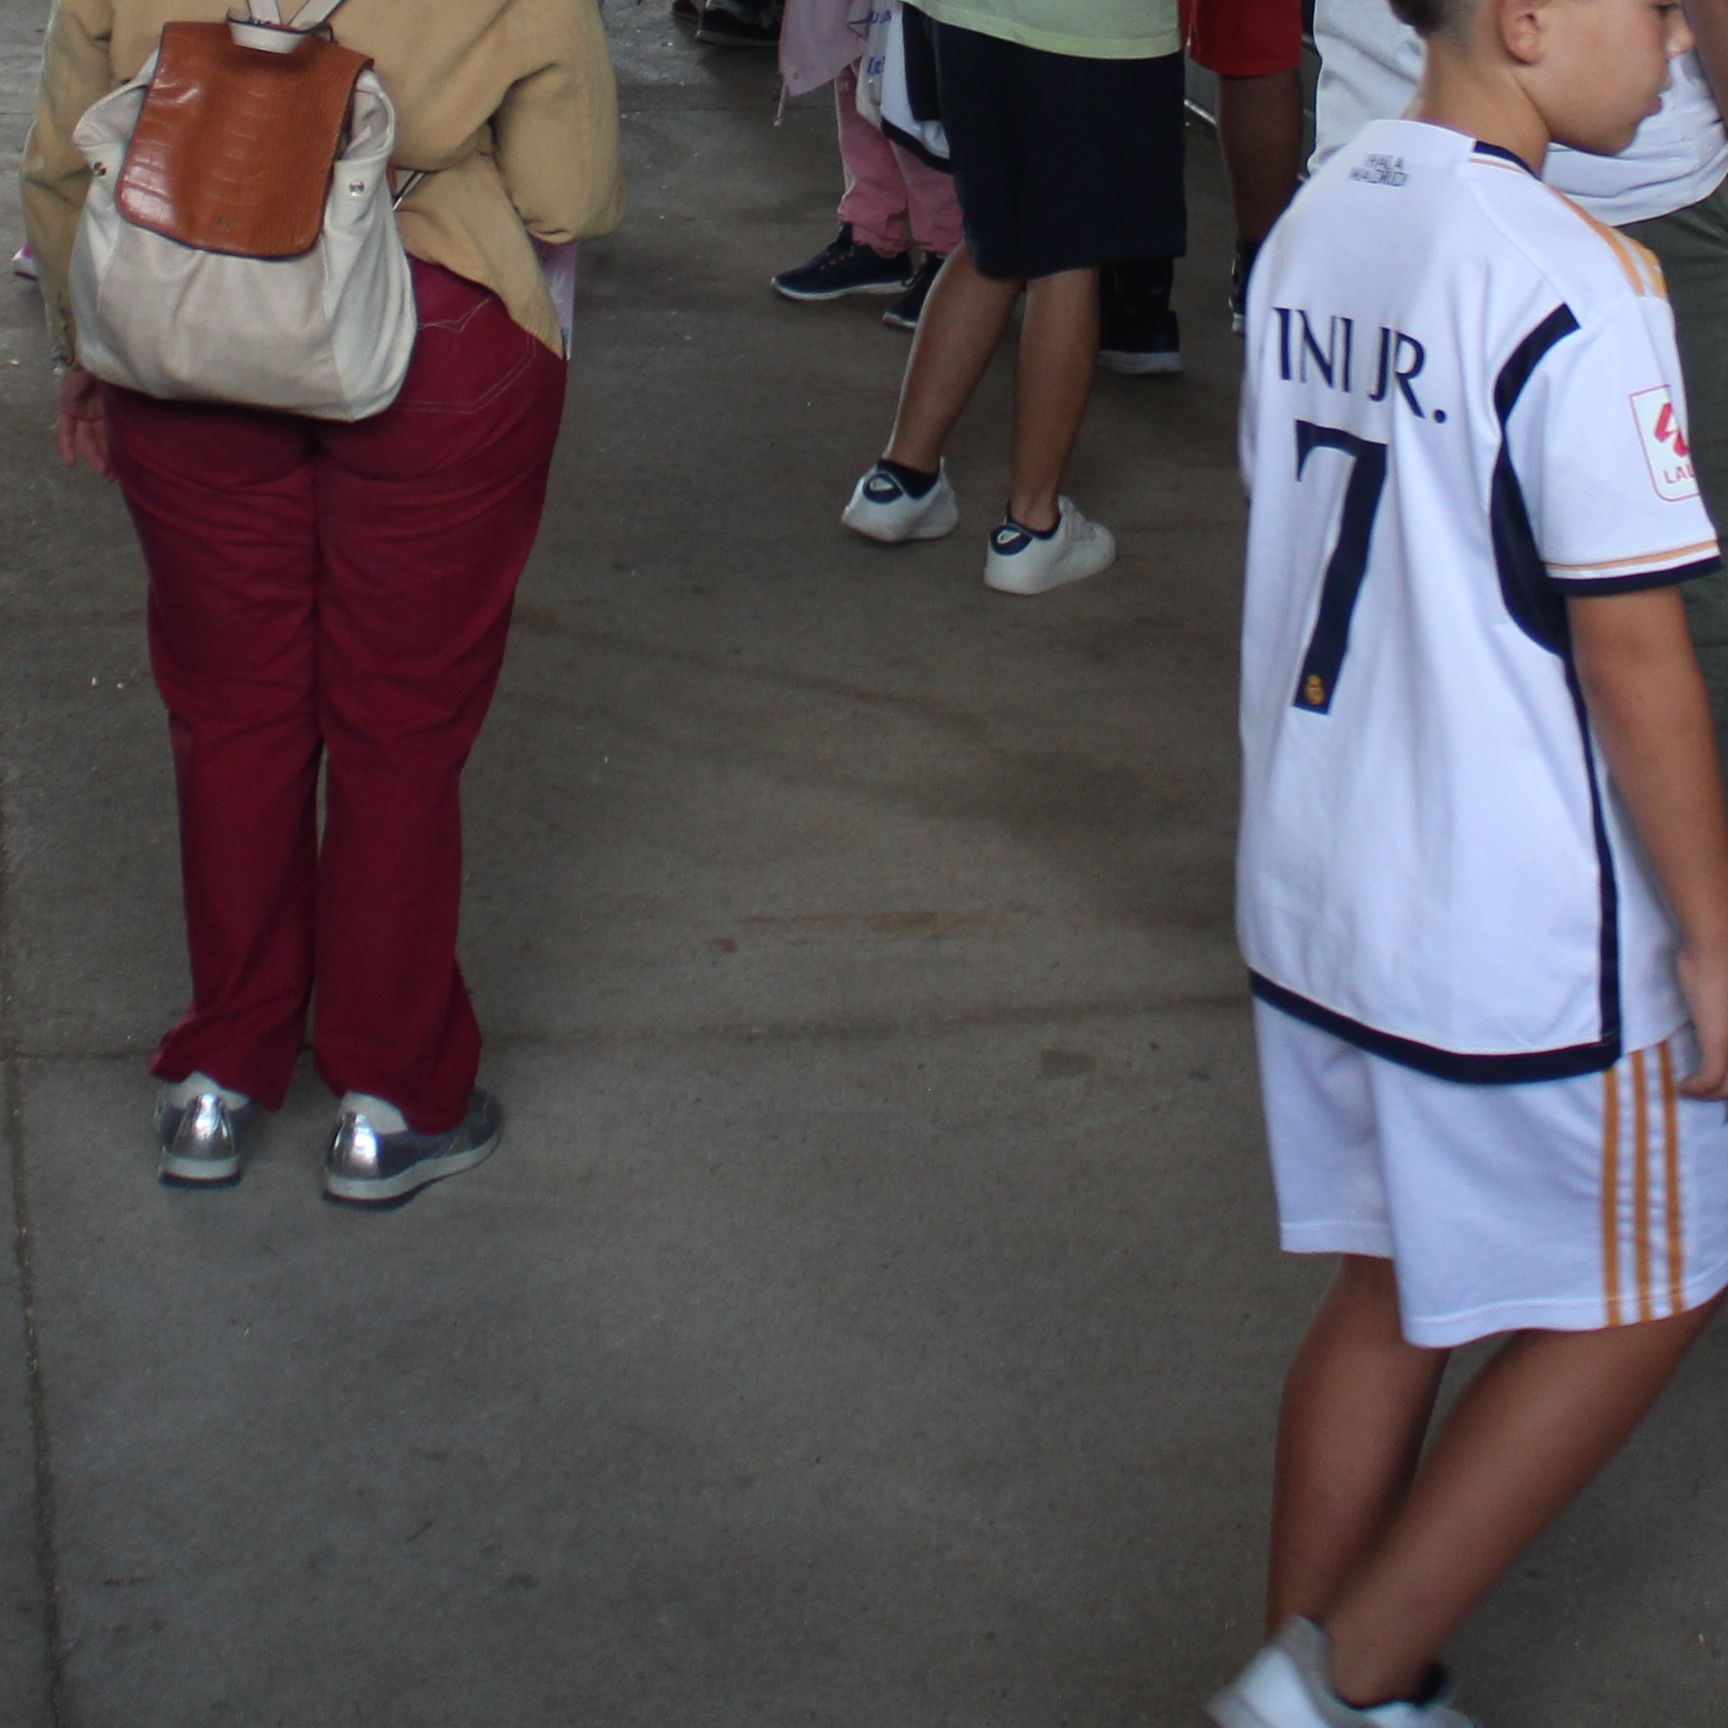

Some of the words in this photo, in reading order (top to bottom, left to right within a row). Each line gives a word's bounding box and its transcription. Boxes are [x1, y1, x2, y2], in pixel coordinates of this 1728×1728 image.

[1271, 306, 1354, 393] INI
[1368, 325, 1448, 424] JR.
[1293, 419, 1388, 715] 7
